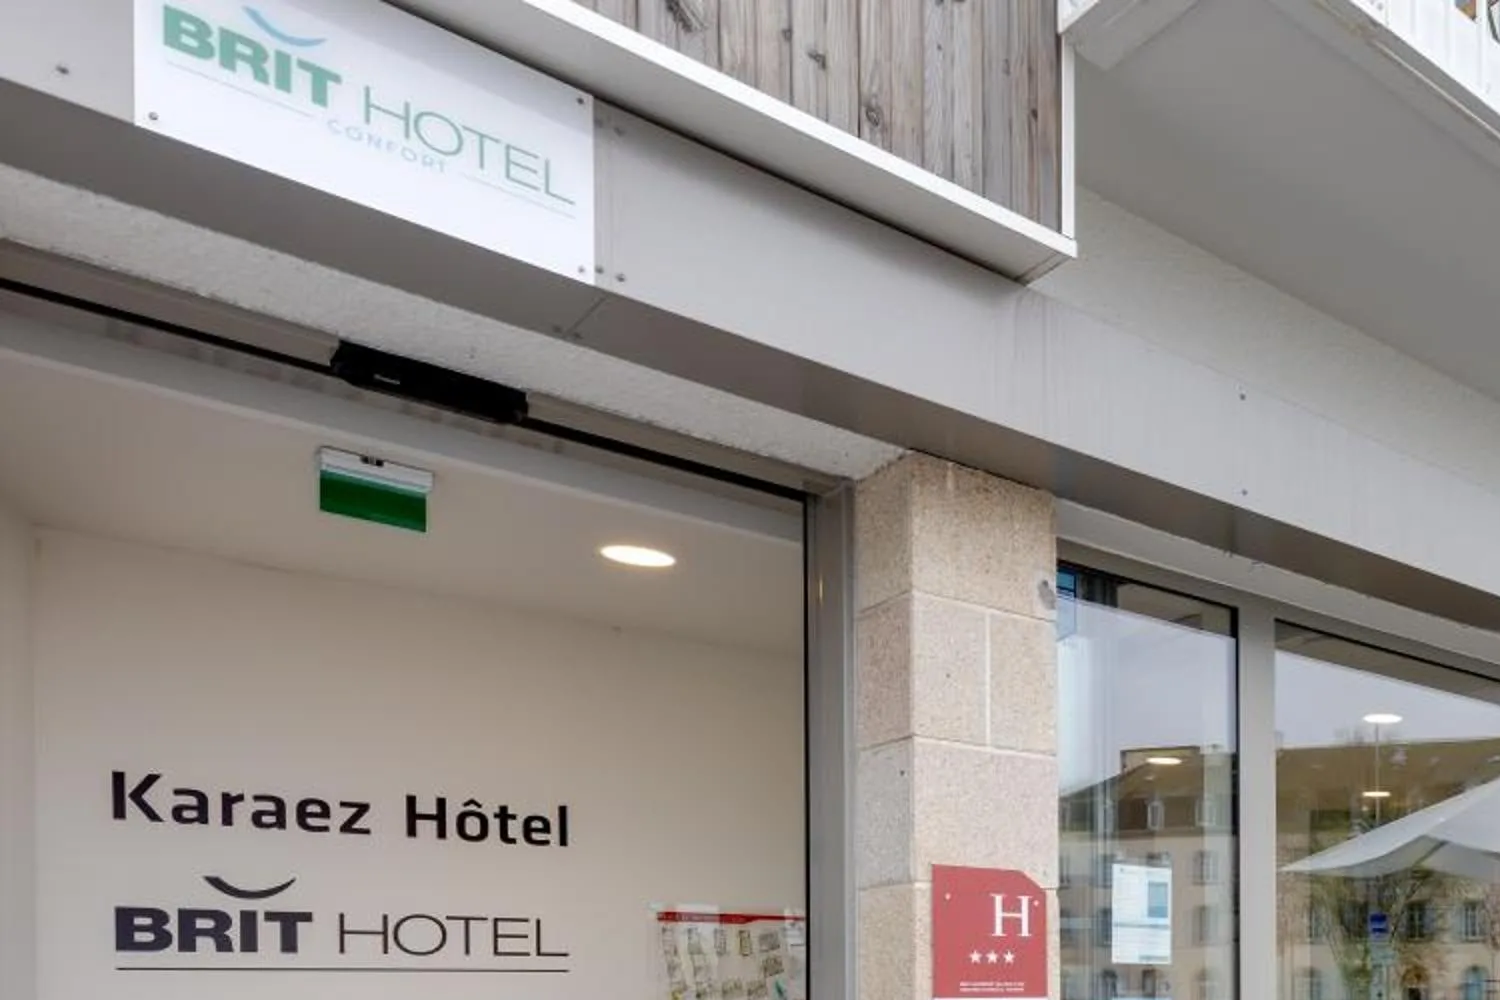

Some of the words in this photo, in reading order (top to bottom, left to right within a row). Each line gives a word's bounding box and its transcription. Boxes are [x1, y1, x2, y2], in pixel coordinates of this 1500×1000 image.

[162, 4, 342, 109] BRIT
[363, 84, 577, 206] HOTEL
[326, 118, 448, 174] CONFORT
[110, 769, 373, 836] Karaez
[405, 793, 570, 848] Hôtel
[113, 905, 314, 954] BRIT
[338, 911, 571, 957] HOTEL
[990, 893, 1034, 937] H
